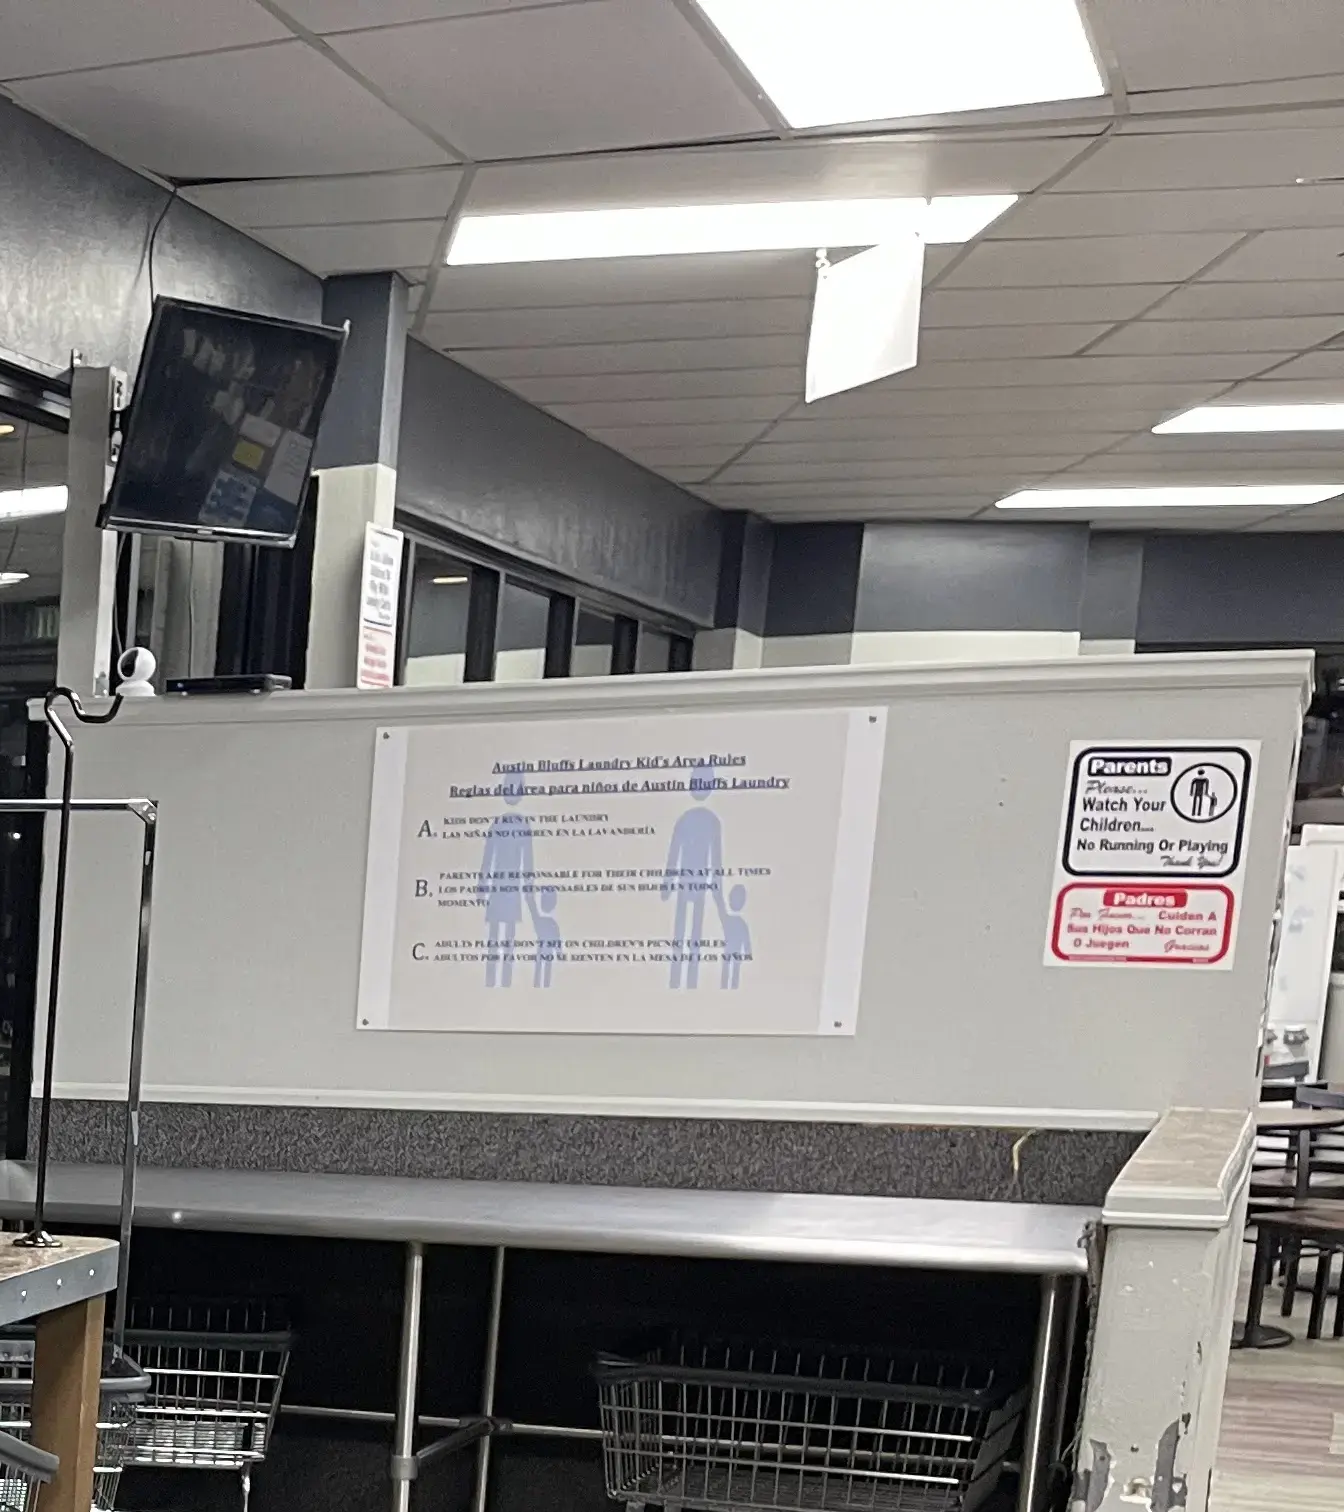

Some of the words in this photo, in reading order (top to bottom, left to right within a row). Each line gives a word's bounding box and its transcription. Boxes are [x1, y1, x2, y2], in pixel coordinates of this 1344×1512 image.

[492, 761, 534, 774] Austin
[538, 760, 575, 772] Bluffs
[580, 757, 631, 771] Laundry
[636, 755, 669, 768] Kid's
[672, 755, 705, 767] Area
[709, 753, 746, 766] Rules
[1090, 759, 1169, 774] Parents
[449, 785, 490, 798] Reglas
[494, 784, 514, 797] del
[548, 783, 578, 796] para
[582, 781, 618, 794] niños
[622, 780, 638, 792] de
[640, 779, 685, 792] Austin
[689, 778, 727, 791] Bluffs
[732, 776, 790, 789] Laundry
[1082, 797, 1128, 812] Watch
[1133, 797, 1166, 812] Your
[1077, 838, 1095, 851] No
[1100, 838, 1154, 854] Running
[1159, 840, 1176, 851] Or
[1179, 840, 1228, 854] Playing
[1114, 892, 1175, 906] Padres
[1159, 911, 1203, 921] Cuiden
[1208, 912, 1217, 921] A
